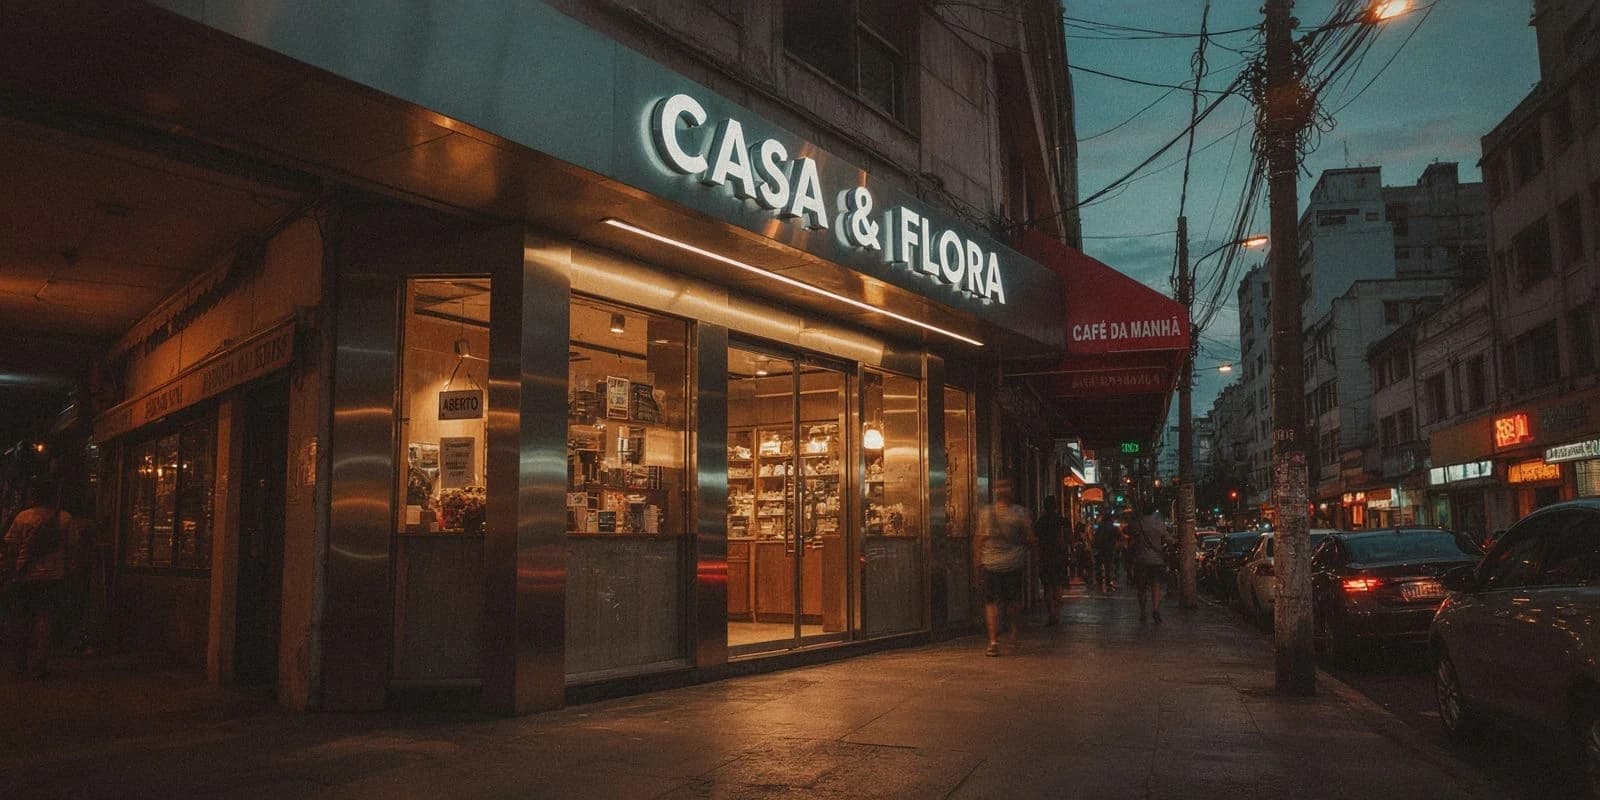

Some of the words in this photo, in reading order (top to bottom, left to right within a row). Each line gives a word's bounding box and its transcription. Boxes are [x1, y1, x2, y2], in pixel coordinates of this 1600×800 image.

[655, 94, 829, 230] CASA
[849, 186, 881, 250] &
[898, 205, 1006, 305] FLORA
[1072, 320, 1107, 342] CAFÉ
[1110, 322, 1128, 340] DA
[1130, 316, 1181, 338] MANHÃ
[442, 396, 479, 412] ABERTO
